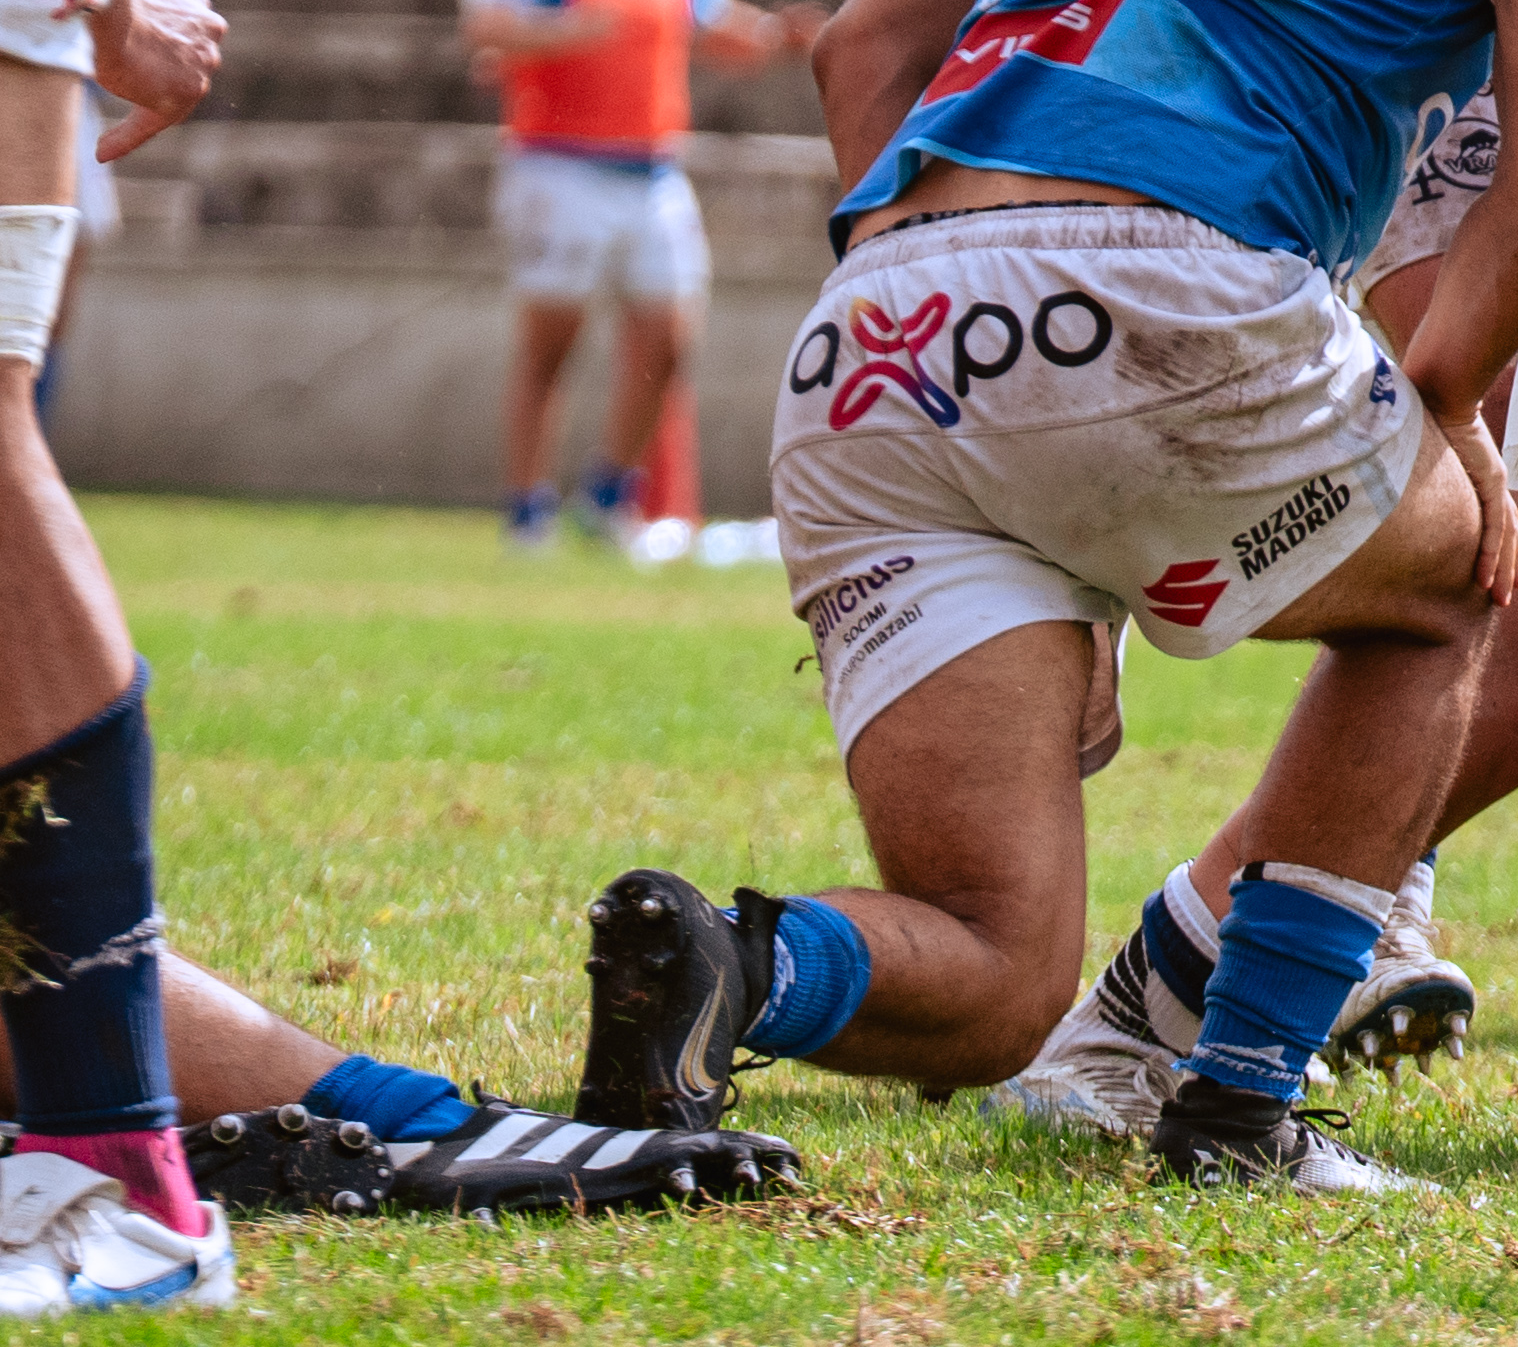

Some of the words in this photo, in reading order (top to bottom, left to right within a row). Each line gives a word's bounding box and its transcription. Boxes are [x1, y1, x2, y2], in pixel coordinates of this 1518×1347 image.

[1231, 473, 1335, 557] SUZUKI
[1239, 482, 1352, 582] MADRID
[843, 601, 888, 649] SOCIMI
